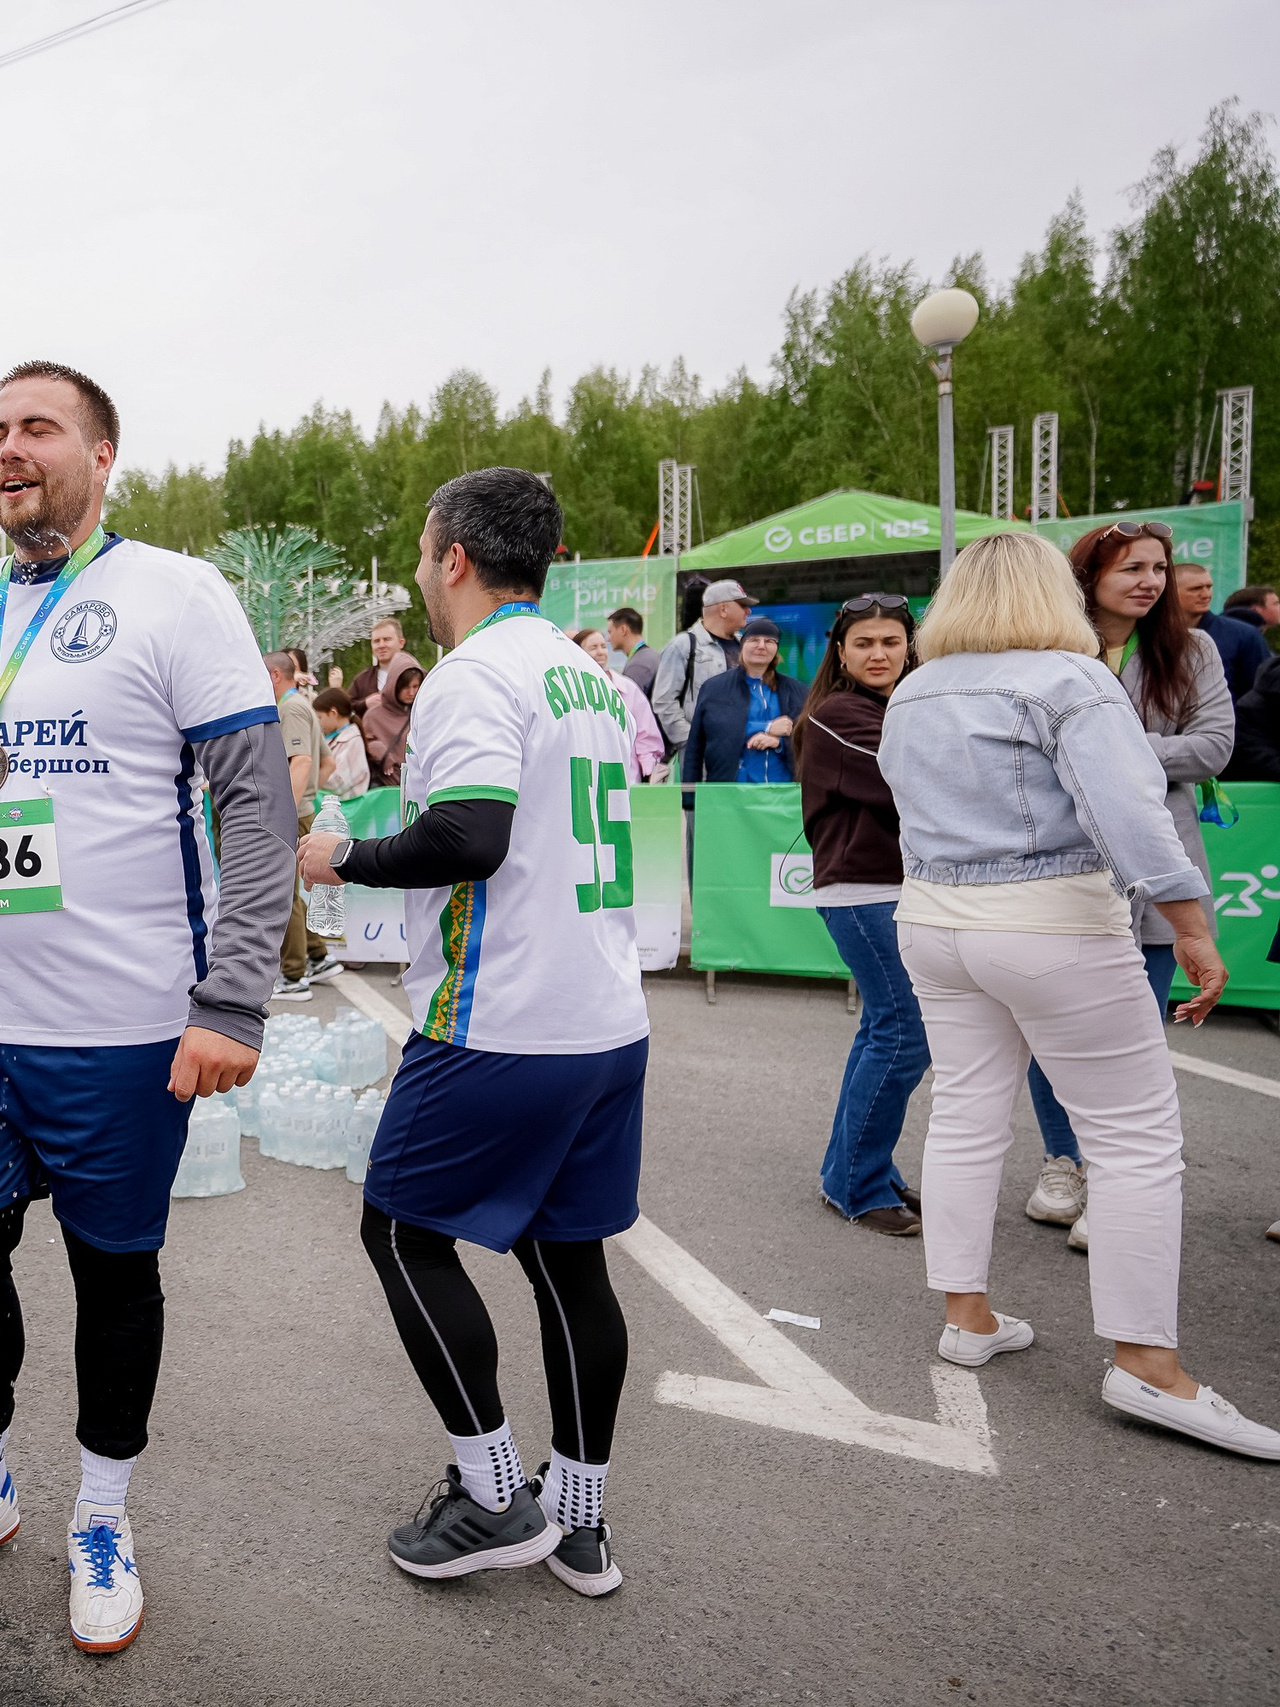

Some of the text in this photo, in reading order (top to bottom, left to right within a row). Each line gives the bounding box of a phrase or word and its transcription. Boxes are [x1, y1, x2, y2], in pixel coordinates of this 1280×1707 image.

[799, 519, 929, 546] СБЕР 185
[577, 584, 658, 606] ритме
[64, 602, 111, 621] САМАРОВО
[8, 752, 110, 779] бершоп
